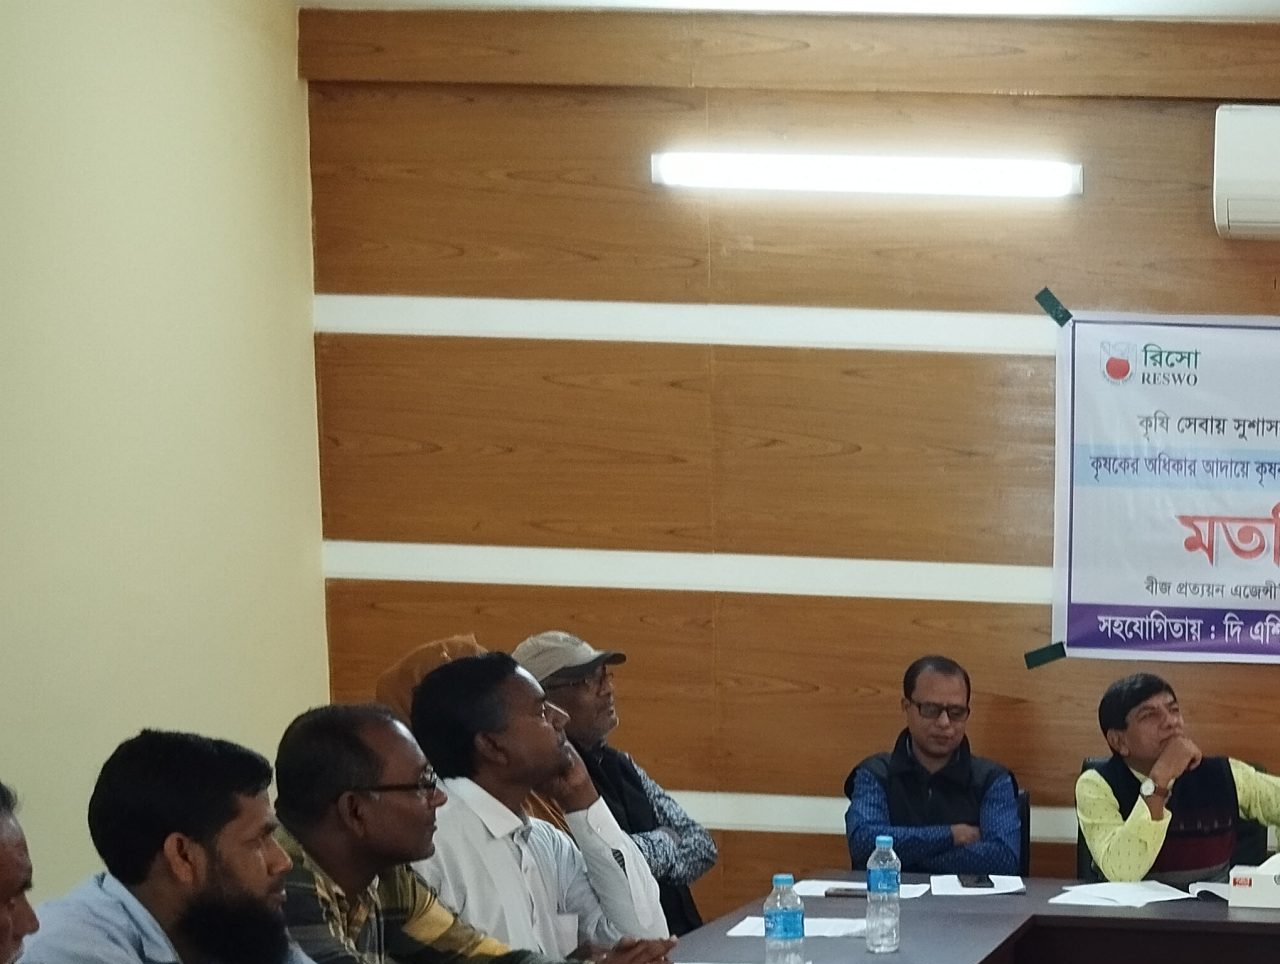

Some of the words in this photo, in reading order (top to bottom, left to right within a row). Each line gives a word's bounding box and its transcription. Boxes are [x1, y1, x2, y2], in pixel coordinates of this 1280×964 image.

[1141, 343, 1201, 370] রিসো
[1141, 372, 1198, 387] RESWO
[1137, 409, 1171, 442] কৃষি
[1177, 415, 1228, 435] সেবায়
[1089, 456, 1140, 482] কৃষকের
[1144, 452, 1198, 477] অধিকার
[1201, 457, 1250, 479] আদায়ে
[1144, 575, 1172, 597] বীজ
[1176, 580, 1225, 598] প্রত্যয়ন
[1097, 609, 1204, 643] সহযোগিতায়
[1222, 612, 1245, 644] দি
